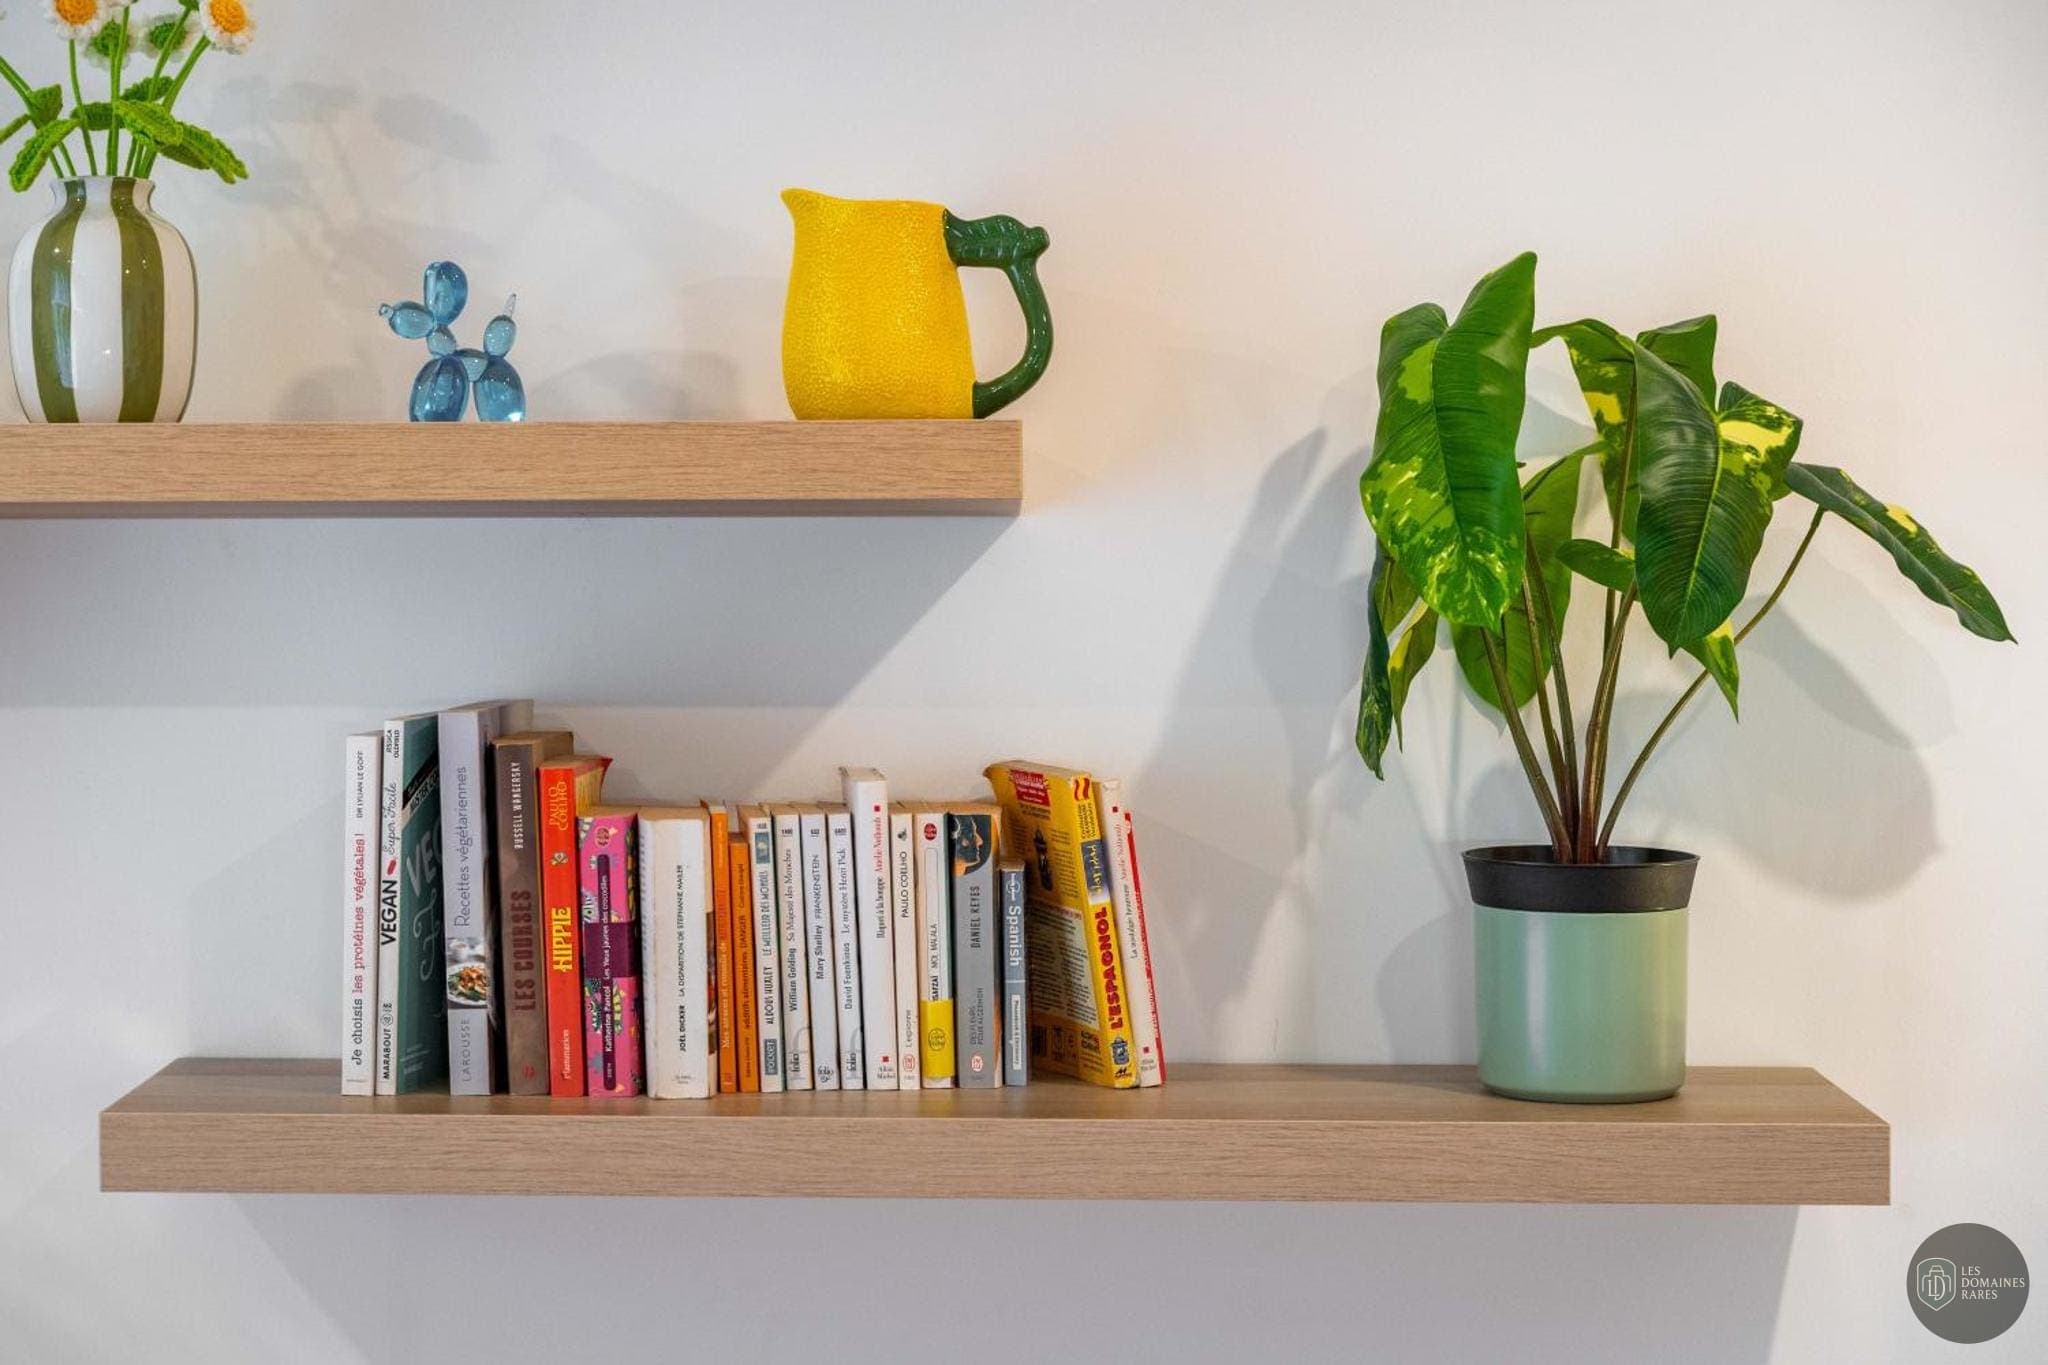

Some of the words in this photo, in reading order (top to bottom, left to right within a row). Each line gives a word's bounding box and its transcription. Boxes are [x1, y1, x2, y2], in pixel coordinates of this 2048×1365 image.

[356, 750, 364, 770] GOFF
[382, 782, 397, 818] Facile
[456, 766, 473, 862] végétariennes
[548, 786, 559, 826] PAULO
[558, 781, 568, 832] COELHO
[383, 820, 400, 856] Super
[514, 815, 524, 850] RUSSELL
[676, 864, 684, 890] MAILER
[782, 849, 793, 884] Mouches
[838, 868, 848, 890] Henri
[900, 851, 908, 888] COELHO
[454, 866, 471, 927] Recettes
[600, 874, 608, 910] crocodiles
[784, 886, 794, 898] des
[812, 854, 822, 920] FRANKENSTEIN
[970, 886, 980, 914] KEYES
[381, 880, 398, 946] VEGAN
[600, 912, 608, 924] des
[760, 901, 770, 912] DES
[900, 890, 909, 918] PAULO
[352, 906, 365, 969] protéines
[510, 890, 534, 972] COURSES
[551, 907, 573, 973] HIPPIE
[602, 926, 611, 950] jaunes
[676, 931, 684, 941] DE
[760, 914, 771, 946] MEILLEUR
[786, 932, 795, 942] Sa
[814, 924, 824, 956] Shelley
[841, 923, 850, 934] Le
[930, 923, 938, 950] MALALA
[970, 918, 981, 949] DANIEL
[1006, 906, 1022, 966] Spanish
[677, 943, 685, 986] DISPARITION
[763, 966, 774, 994] HUXLEY
[787, 948, 798, 980] Golding
[815, 958, 826, 980] Mary
[1094, 907, 1124, 1030] L'ESPAGNOL
[352, 976, 363, 993] les
[513, 979, 536, 1012] LES
[602, 986, 612, 1012] Pancol
[678, 988, 686, 998] LA
[788, 980, 798, 1012] William
[844, 986, 853, 1010] David
[352, 999, 363, 1044] choisis
[764, 996, 774, 1025] ALDOUS
[604, 1014, 613, 1052] Katherine
[352, 1050, 363, 1065] Je
[382, 1028, 392, 1080] MARABOUT
[461, 1018, 473, 1082] LAROUSSE
[846, 1052, 857, 1072] folio
